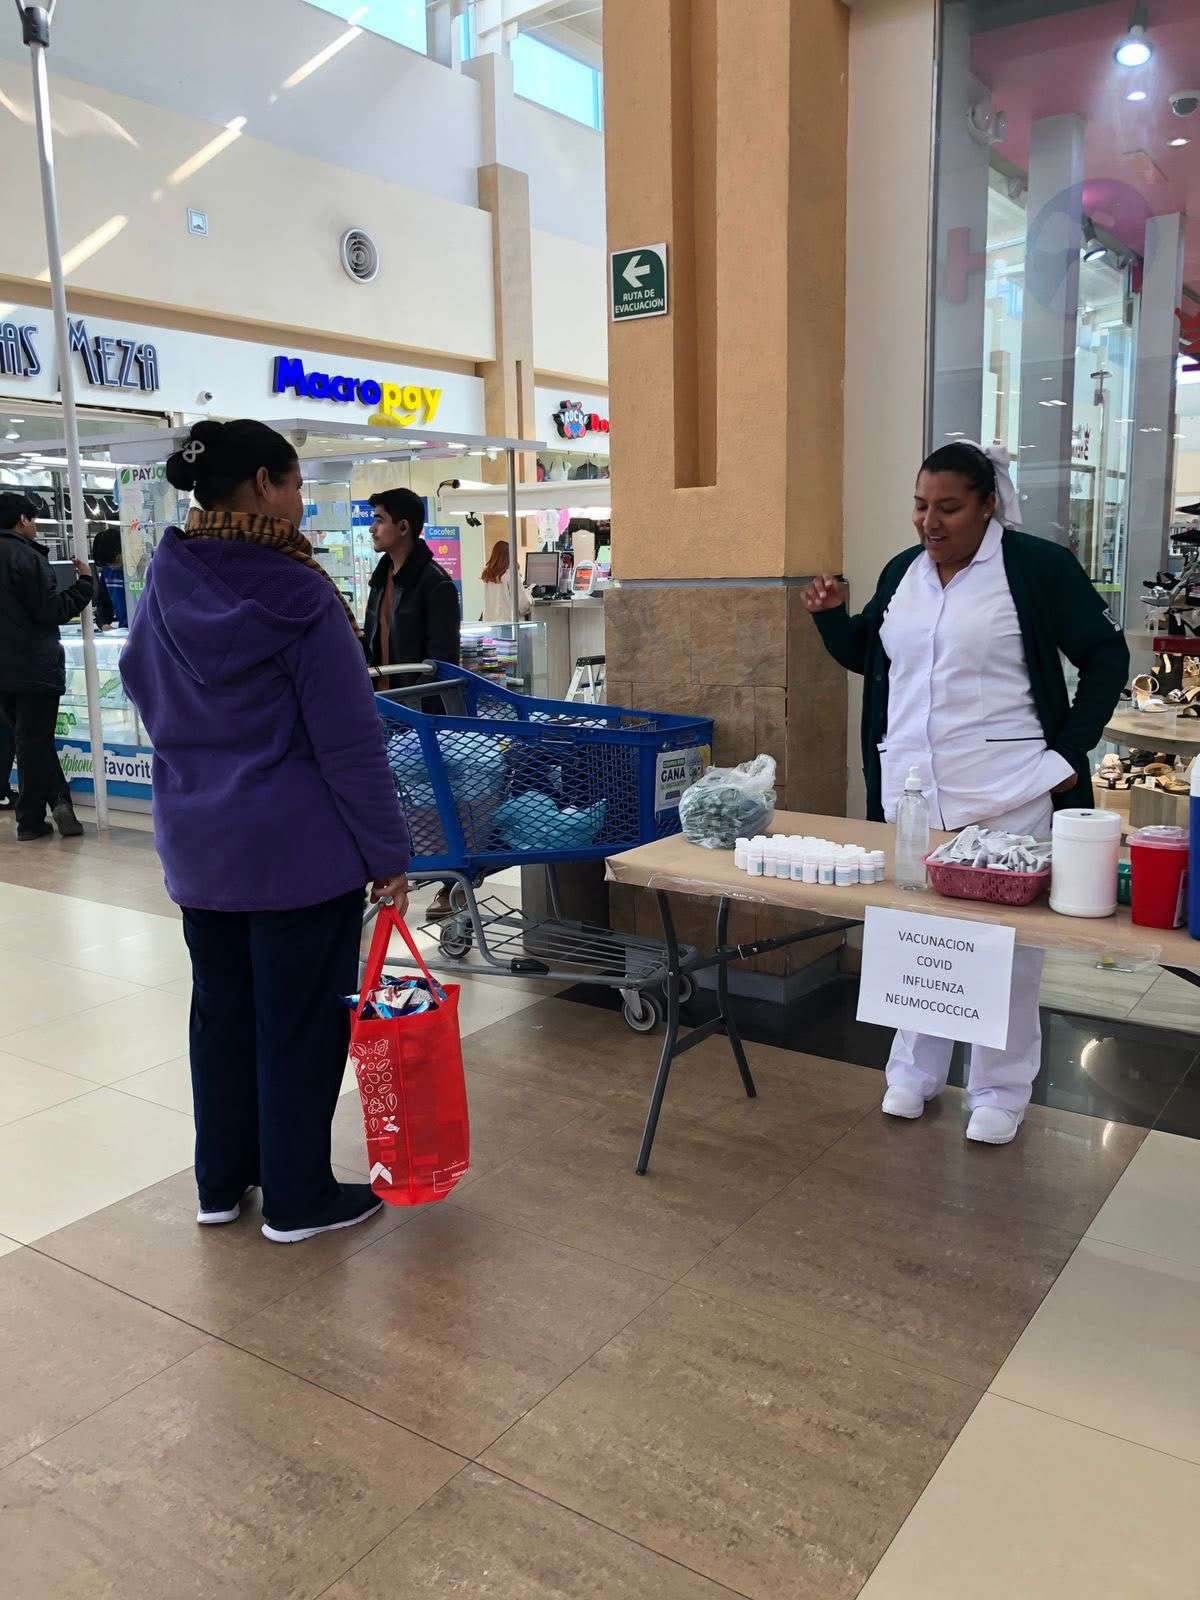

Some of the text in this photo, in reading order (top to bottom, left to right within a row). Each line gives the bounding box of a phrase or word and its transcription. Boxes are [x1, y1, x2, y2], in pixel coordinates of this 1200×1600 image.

[623, 288, 656, 302] RUTA DE
[58, 317, 160, 391] MEZA
[273, 355, 443, 425] Macropay
[104, 756, 153, 779] favorit
[660, 766, 686, 783] GANA
[898, 930, 975, 953] VACUNACION
[916, 955, 953, 971] COVID
[902, 974, 965, 995] INFLUENZA
[885, 992, 980, 1020] NEUMOCOCCICA
